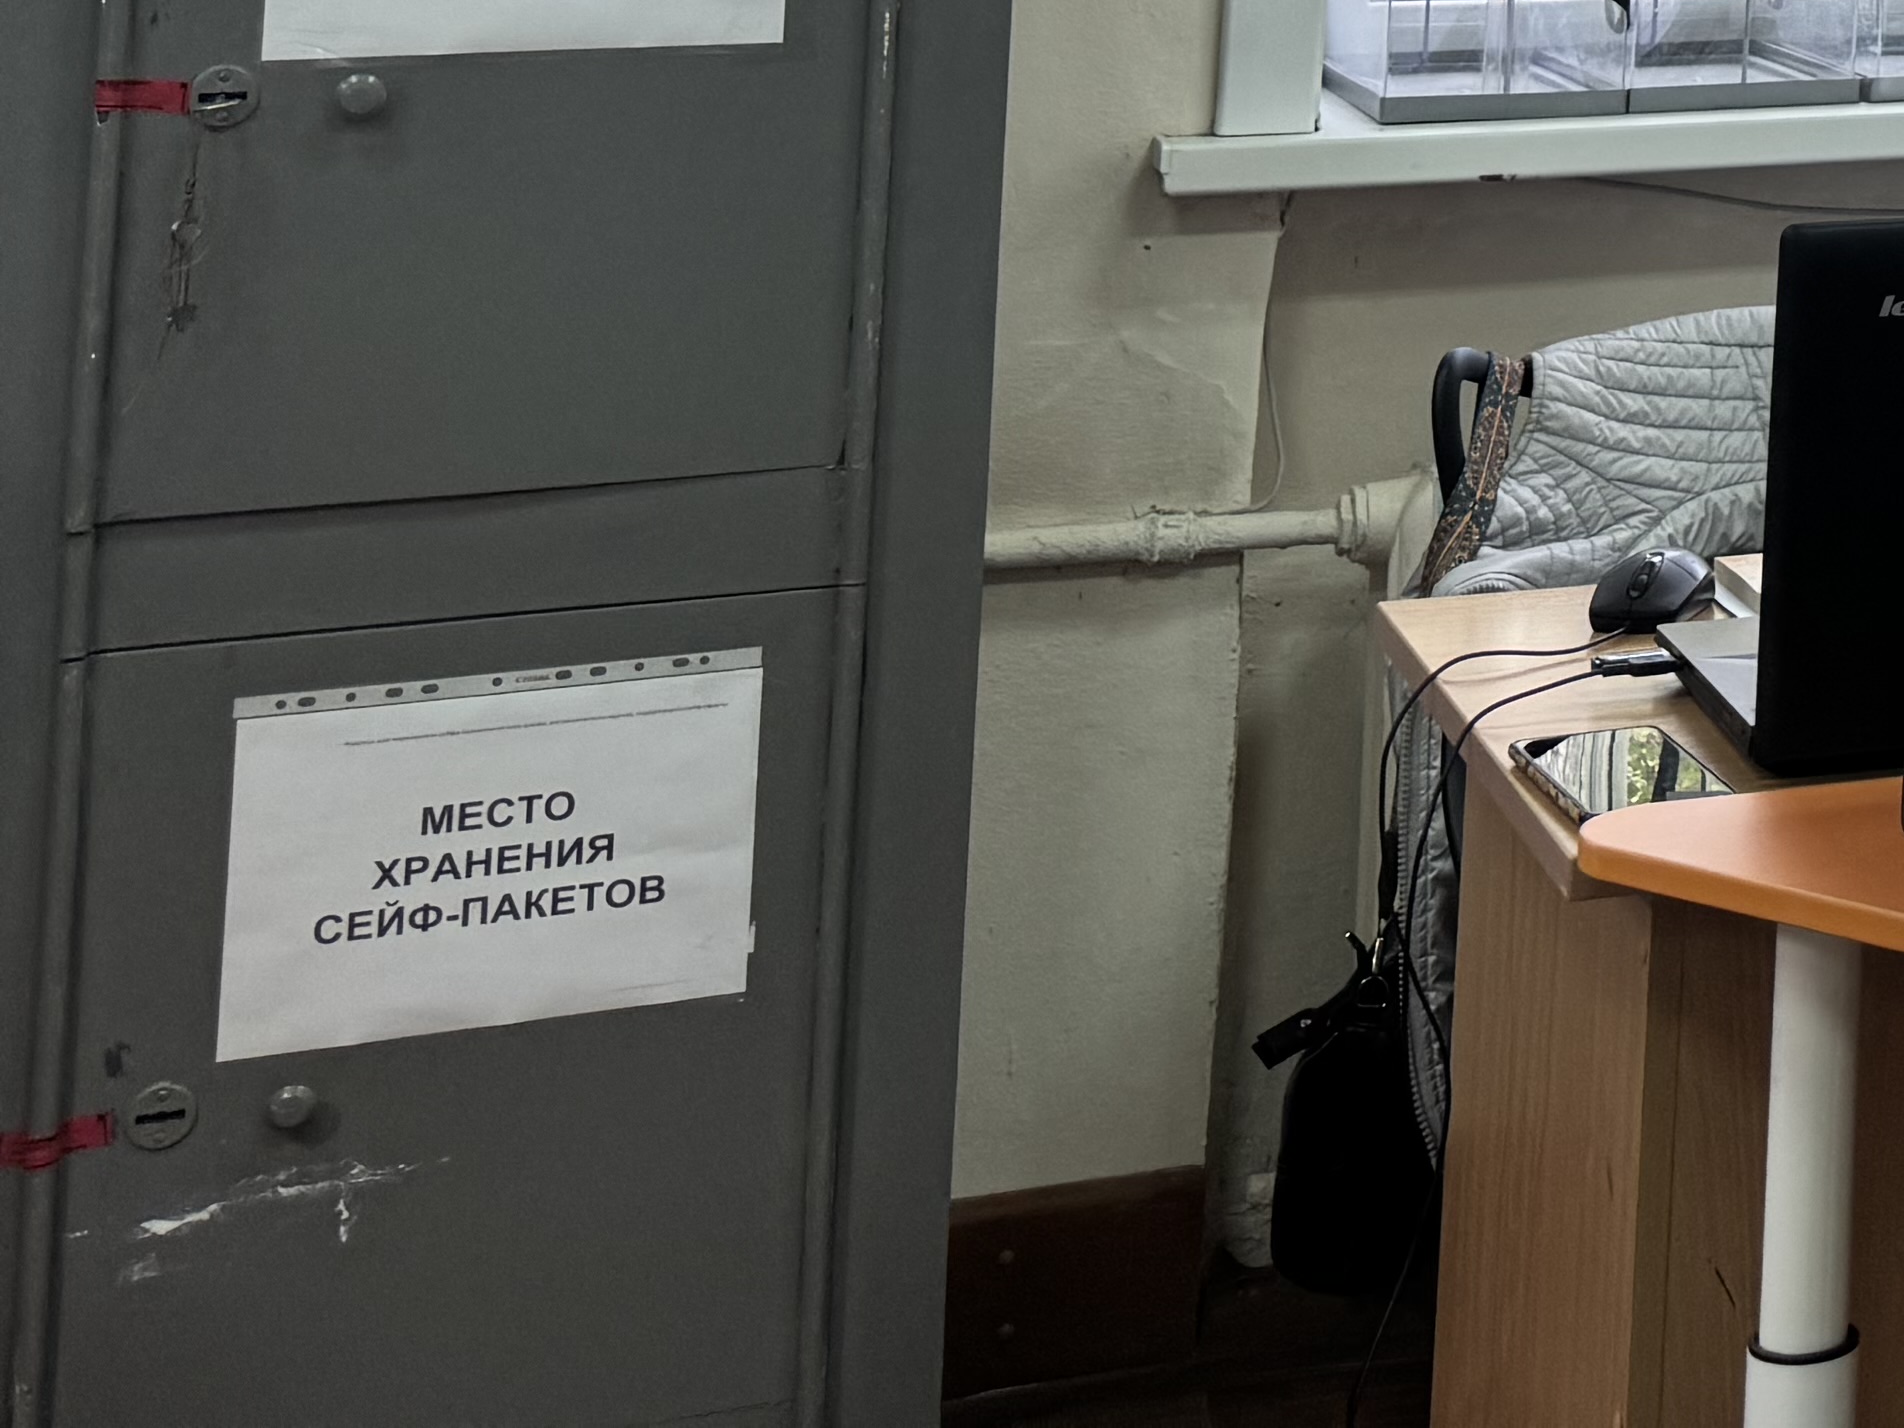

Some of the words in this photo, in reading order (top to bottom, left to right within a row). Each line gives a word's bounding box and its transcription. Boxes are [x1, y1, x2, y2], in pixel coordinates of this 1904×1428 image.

[420, 790, 577, 836] МЕСТО
[371, 832, 617, 891] ХРАНЕНИЯ
[312, 873, 667, 946] СЕЙФ-ПАКЕТОВ
